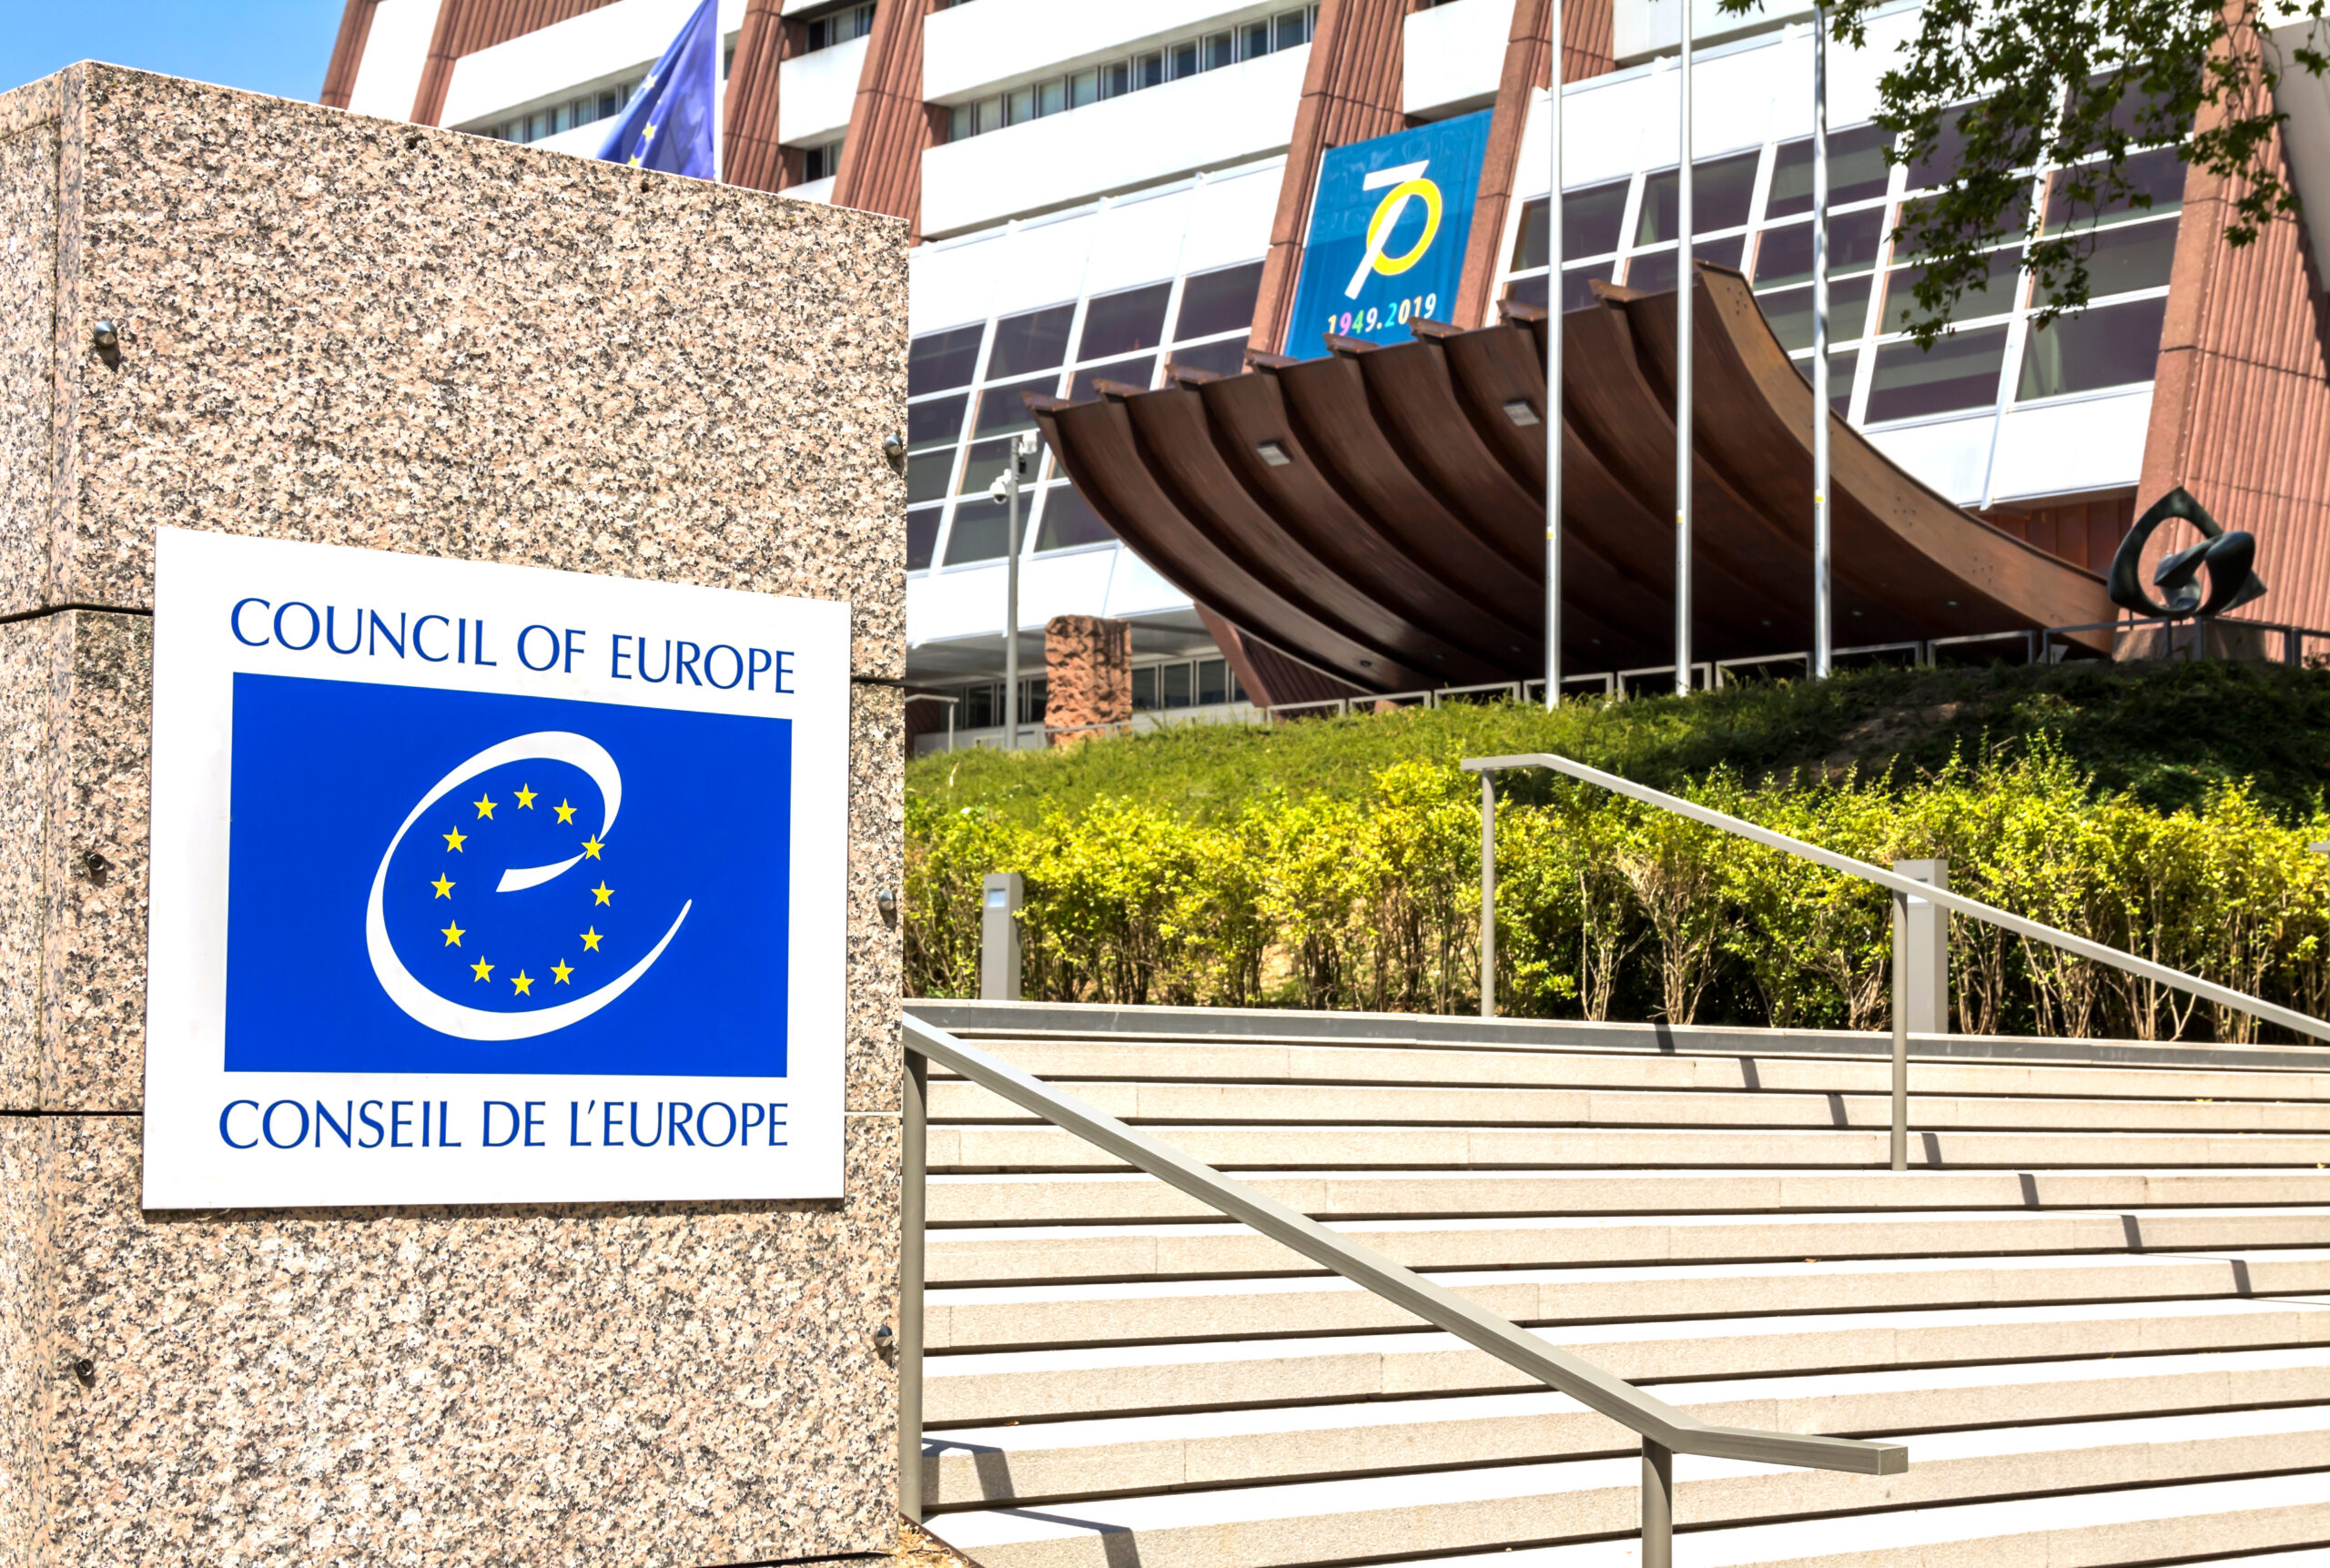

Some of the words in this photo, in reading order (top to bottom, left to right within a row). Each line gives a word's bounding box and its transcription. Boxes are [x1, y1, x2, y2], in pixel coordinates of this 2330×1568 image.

[1344, 159, 1443, 300] 70
[1328, 293, 1437, 337] 1949.2019
[230, 597, 497, 667] COUNCIL
[516, 624, 586, 673] OF
[611, 634, 795, 694] EUROPE
[218, 1099, 462, 1149] CONSEIL
[482, 1100, 546, 1148] DE
[570, 1099, 788, 1148] L'EUROPE
